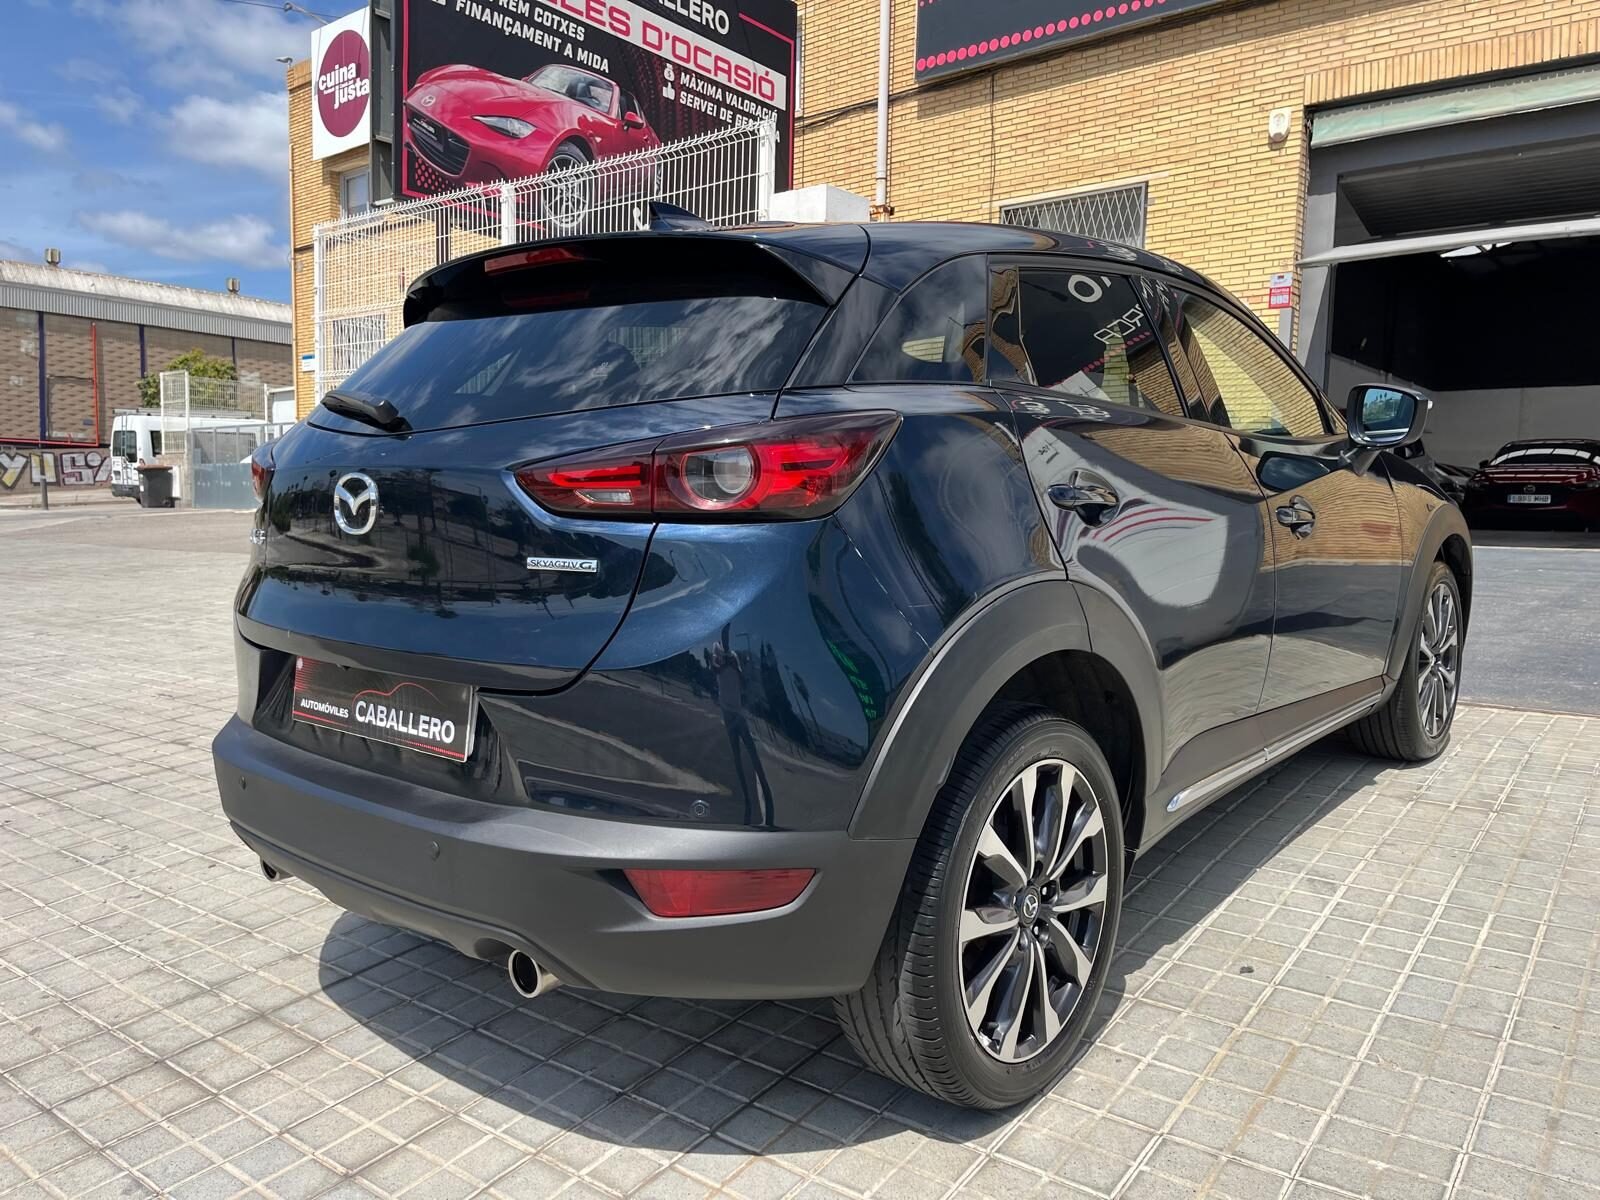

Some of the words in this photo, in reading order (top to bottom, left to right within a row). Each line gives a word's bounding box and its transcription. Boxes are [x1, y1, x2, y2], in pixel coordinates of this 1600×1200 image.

[456, 2, 562, 53] FINANÇAMENT
[563, 42, 573, 59] A
[576, 47, 609, 74] MIDA
[533, 7, 585, 41] COTXES
[318, 62, 357, 91] cuina
[642, 21, 775, 102] D'OCASIÓ
[333, 77, 370, 110] justa
[679, 91, 717, 117] SERVEI
[719, 107, 733, 124] DE
[680, 72, 723, 102] MÀXIMA
[725, 91, 778, 124] VALORACIÓ
[529, 559, 578, 569] SKYACTIV
[300, 698, 349, 718] AUTOMÓVILES
[355, 700, 455, 744] CABALLERO
